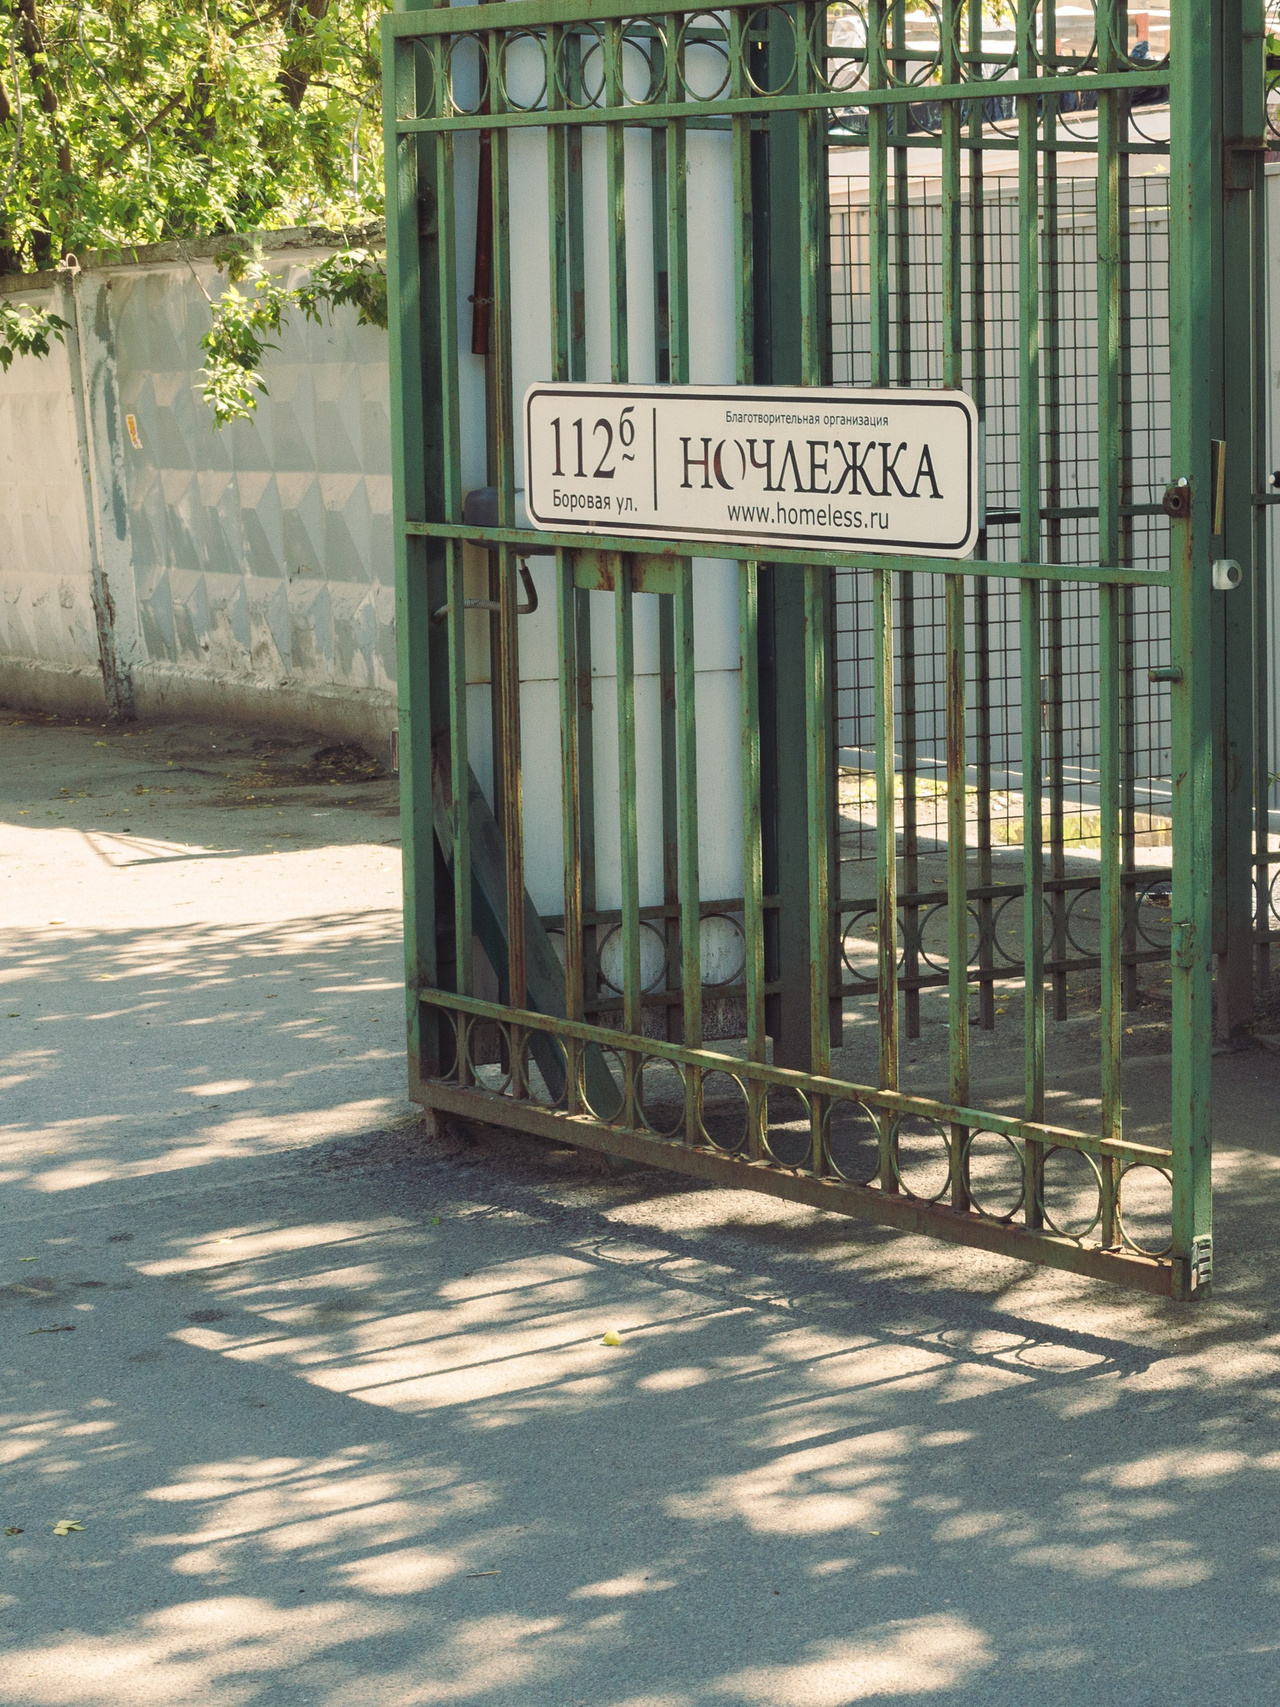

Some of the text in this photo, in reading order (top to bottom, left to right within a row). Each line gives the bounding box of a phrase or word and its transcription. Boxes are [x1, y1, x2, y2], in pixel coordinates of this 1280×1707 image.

[725, 410, 889, 428] Благотворительная организация
[679, 436, 944, 499] НОЧЛЕЖКА
[553, 488, 638, 515] Боровая ул.
[727, 501, 889, 530] www.homeless.ru
